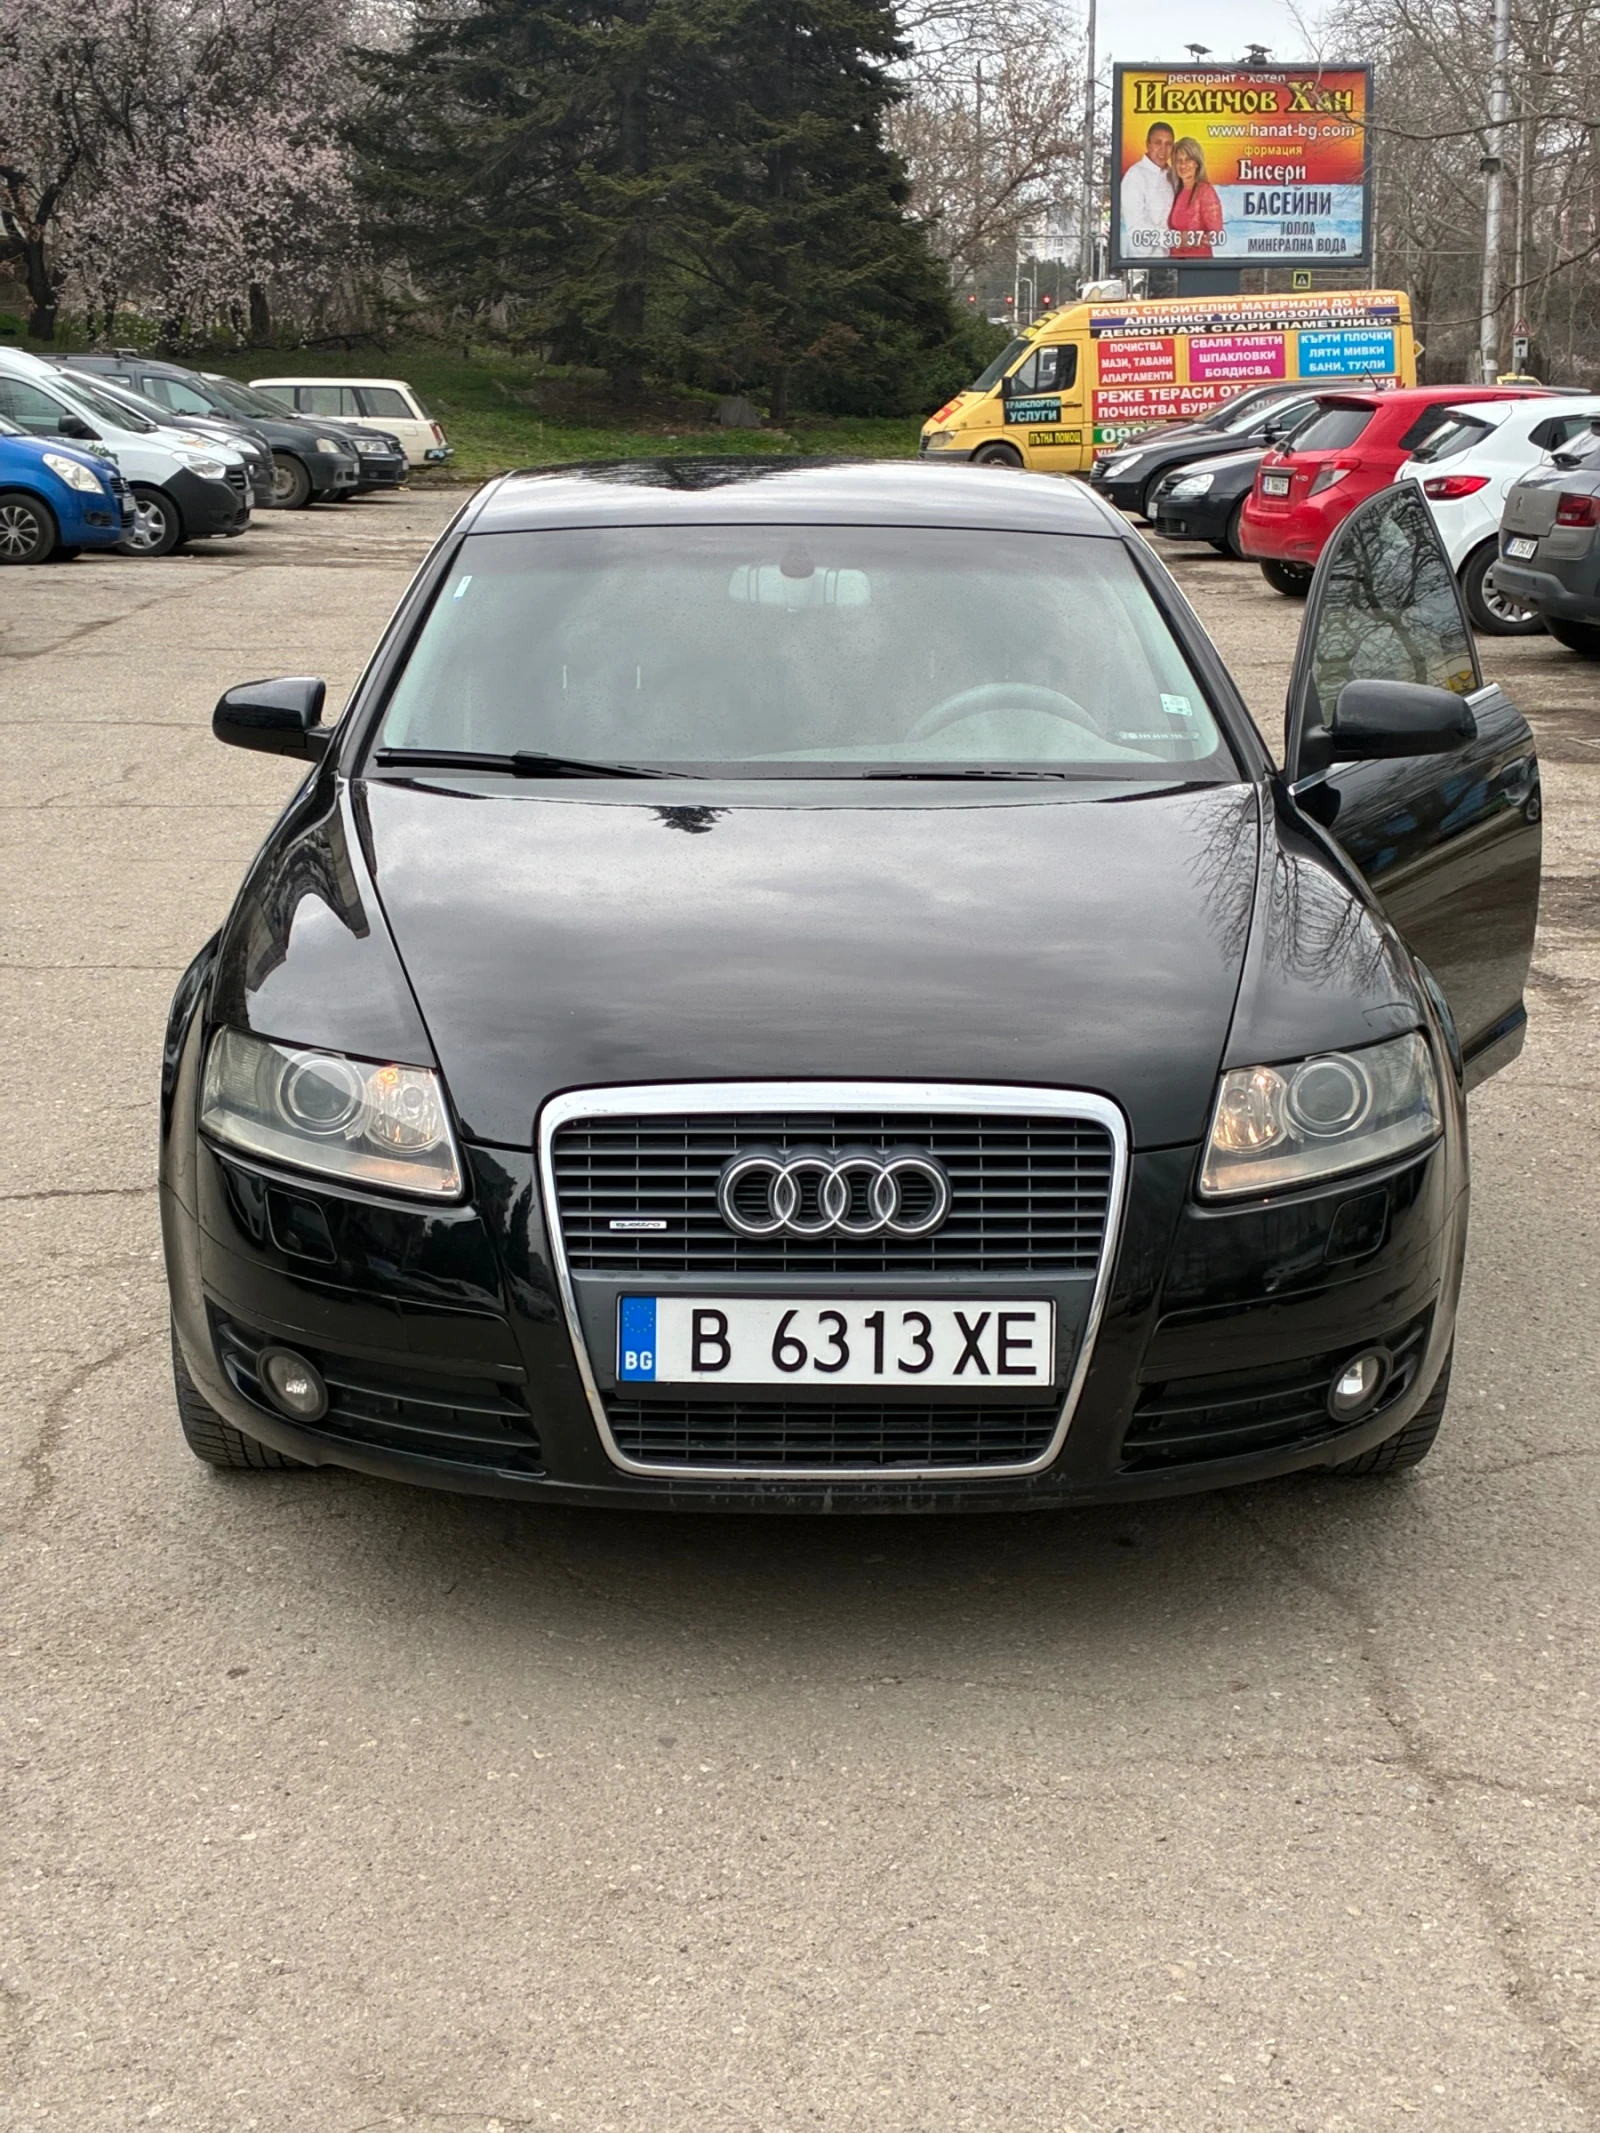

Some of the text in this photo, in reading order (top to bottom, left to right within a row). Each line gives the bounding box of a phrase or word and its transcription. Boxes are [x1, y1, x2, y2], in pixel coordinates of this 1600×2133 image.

[1168, 73, 1236, 86] ресторант
[1134, 80, 1353, 113] Иванчов Хан
[1207, 123, 1356, 141] www.hanat-bg.com
[1244, 144, 1302, 157] формация
[1237, 159, 1307, 187] Бисери
[1243, 187, 1332, 216] БАСЕЙНИ
[1279, 221, 1316, 236] ТОПЛА
[1133, 230, 1226, 247] 052 36 37 30
[1247, 238, 1347, 254] МИНЕРАЛНА ВОДА
[1092, 307, 1139, 318] КАЧВА
[1143, 303, 1237, 315] СТРОИТЕЛНИ
[1241, 299, 1328, 311] МАТЕРИАЛИ
[1332, 298, 1352, 308] ДО
[1124, 314, 1214, 325] АЛПИНИСТ
[1099, 317, 1392, 338] ДЕМОНТАЖ СТАРИ ПАМЕТНИЦИ
[1191, 336, 1283, 349] СВАЛЯ ТАПЕТИ
[1301, 332, 1392, 344] КЪРТИ ПЛОЧКИ
[1110, 341, 1164, 352] ПОЧИСТВА
[1309, 346, 1385, 358] ЛЯТИ МИВКИ
[1101, 356, 1173, 369] МАЗИ, ТАВАНИ
[1199, 351, 1277, 363] ШПАКЛОВКИ
[1205, 365, 1272, 378] БОЯДИСВА
[1309, 360, 1386, 372] БАНИ, ТУХЛИ
[1101, 371, 1174, 383] АПАРТАМЕНТИ
[1098, 390, 1144, 403] РЕЖЕ
[1149, 387, 1214, 401] ТЕРАСИ
[1219, 385, 1241, 397] ОТ
[1005, 399, 1061, 409] ТРАНСПОРТНИ
[1098, 403, 1177, 418] ПОЧИСТВА
[1010, 410, 1058, 422] УСЛУГИ
[1030, 431, 1081, 445] ПЪТНА ПОМОЩ
[691, 1308, 1037, 1375] B 6313 XE
[624, 1350, 653, 1371] BG
